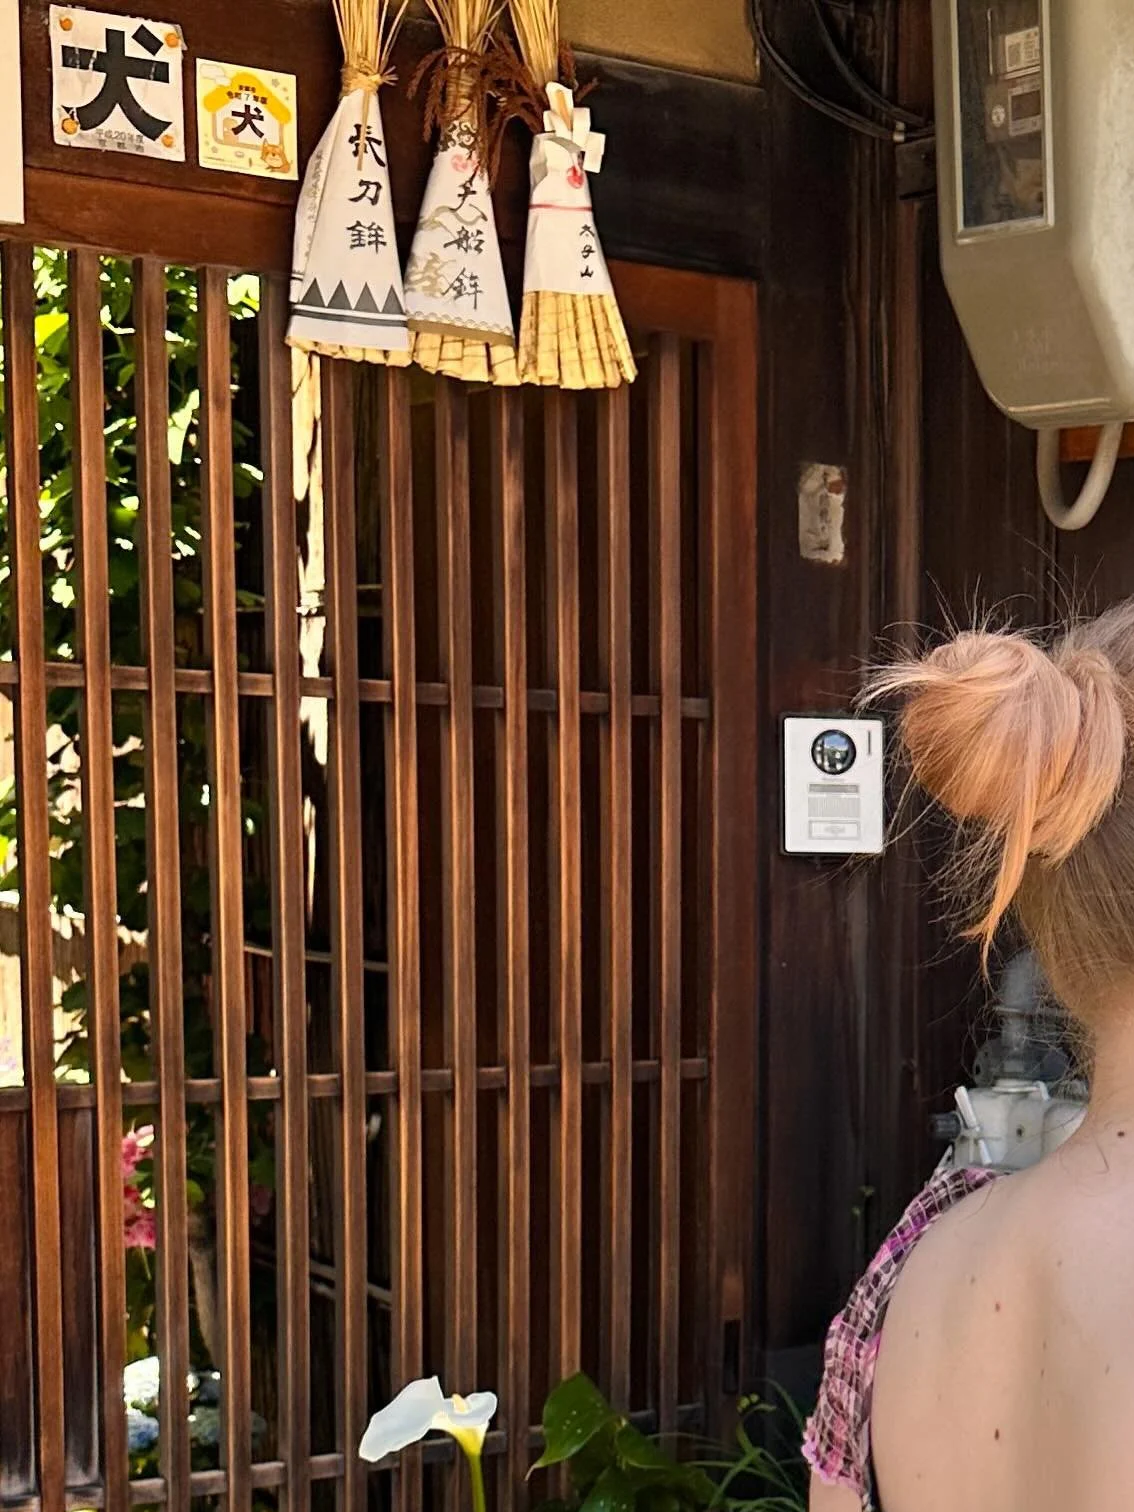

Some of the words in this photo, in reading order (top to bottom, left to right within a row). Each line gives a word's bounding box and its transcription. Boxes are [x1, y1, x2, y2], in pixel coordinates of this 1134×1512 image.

[61, 24, 173, 142] 犬
[231, 104, 265, 138] 犬
[347, 123, 387, 255] 長刀鉾
